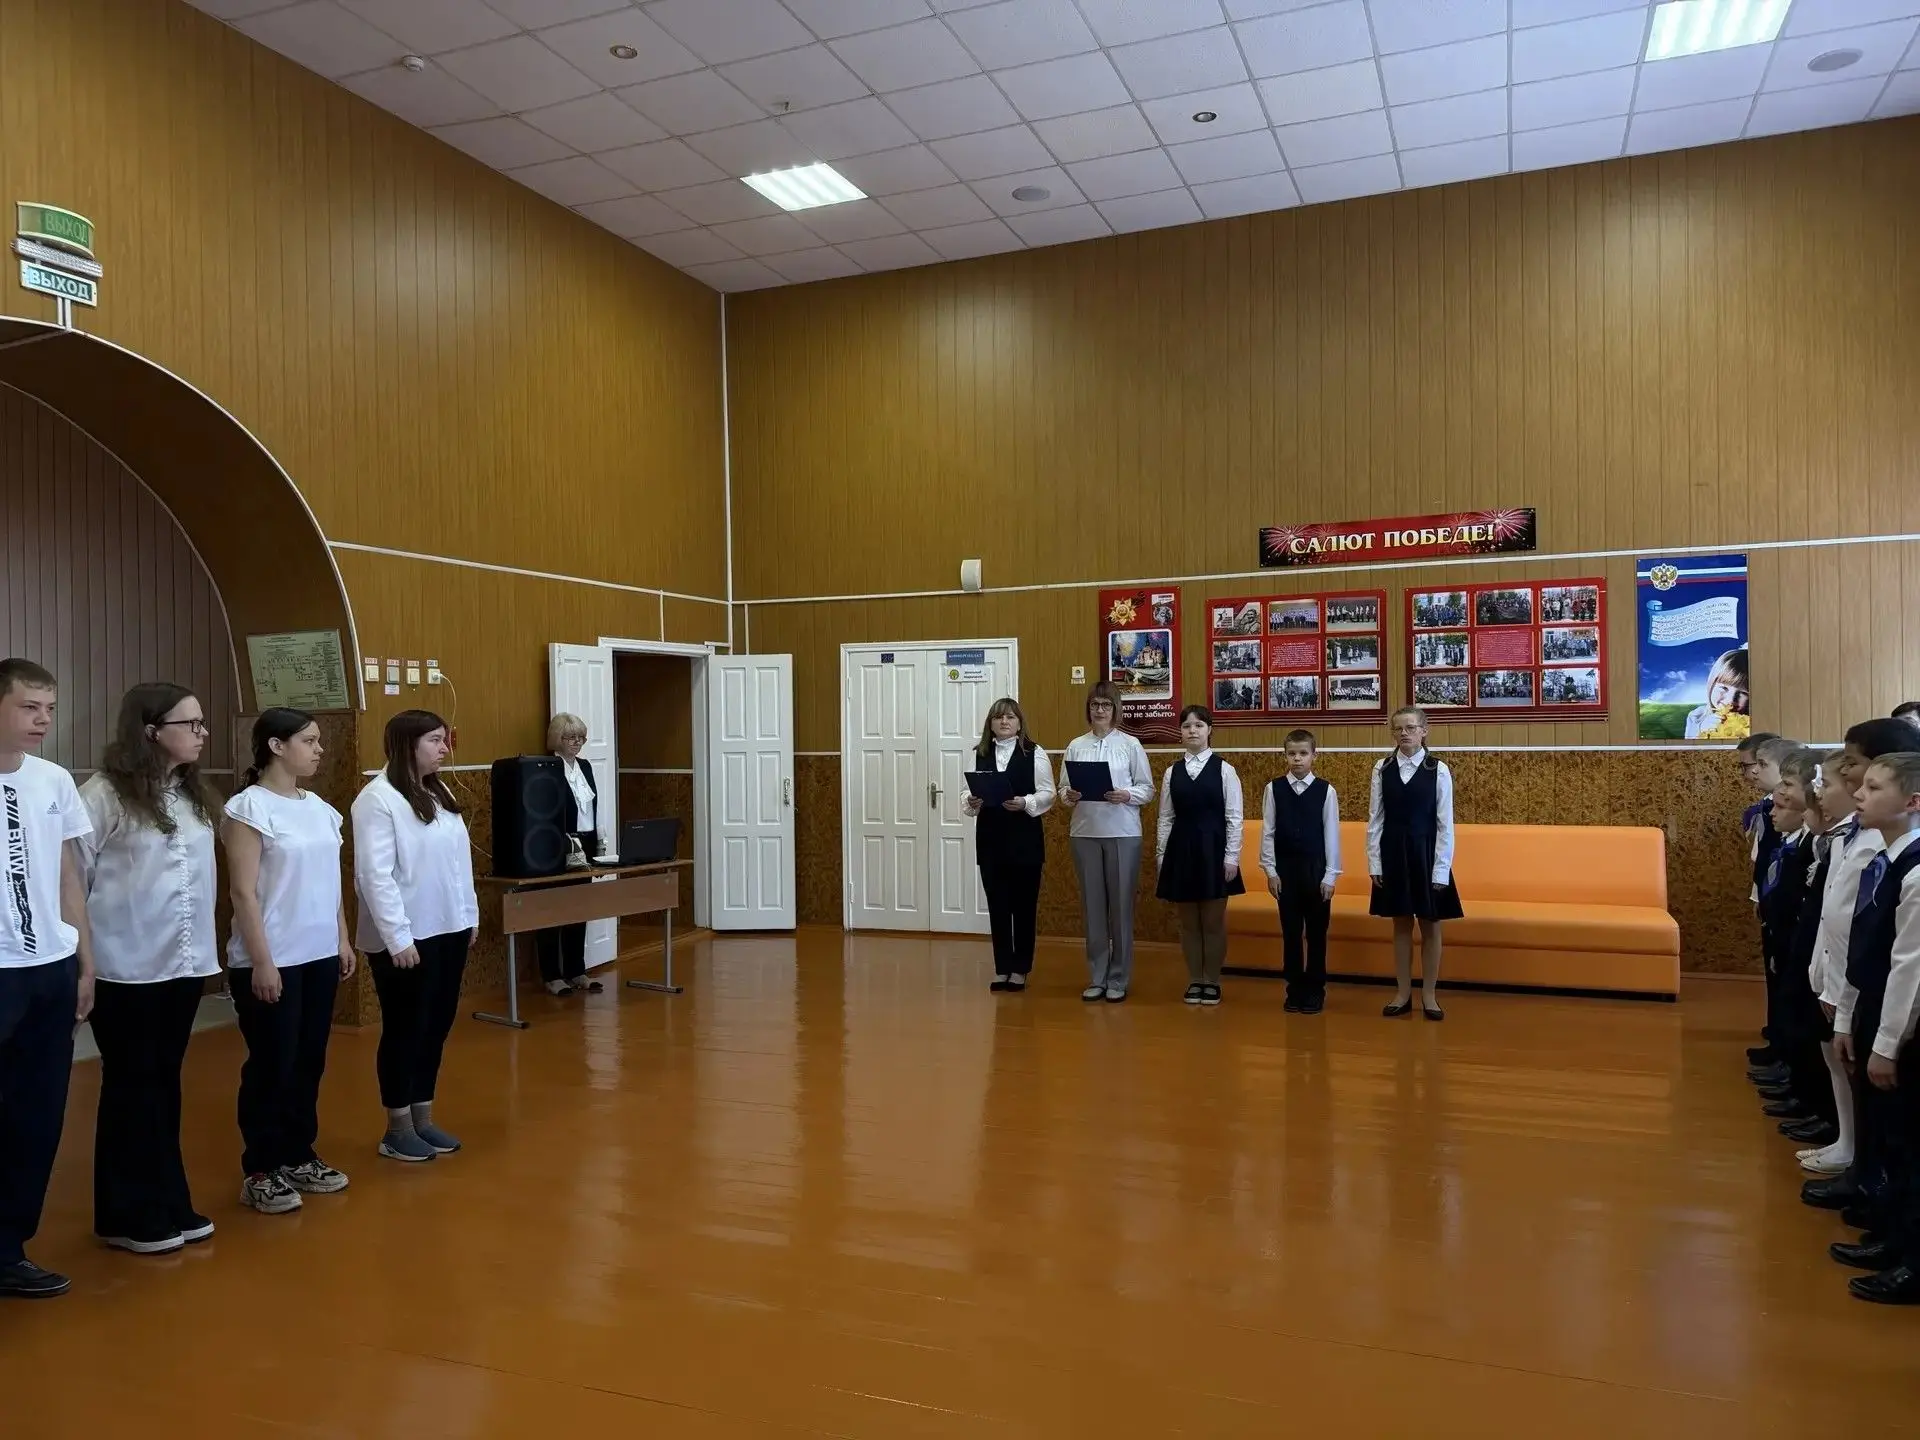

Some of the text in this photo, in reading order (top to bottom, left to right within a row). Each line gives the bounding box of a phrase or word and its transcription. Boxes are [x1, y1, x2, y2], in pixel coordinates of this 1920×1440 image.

[45, 211, 89, 244] ВЫХОД
[29, 268, 90, 299] ВЫХОД
[1290, 524, 1495, 554] САЛЮТ ПОБЕДЕ!
[8, 829, 25, 876] BMW
